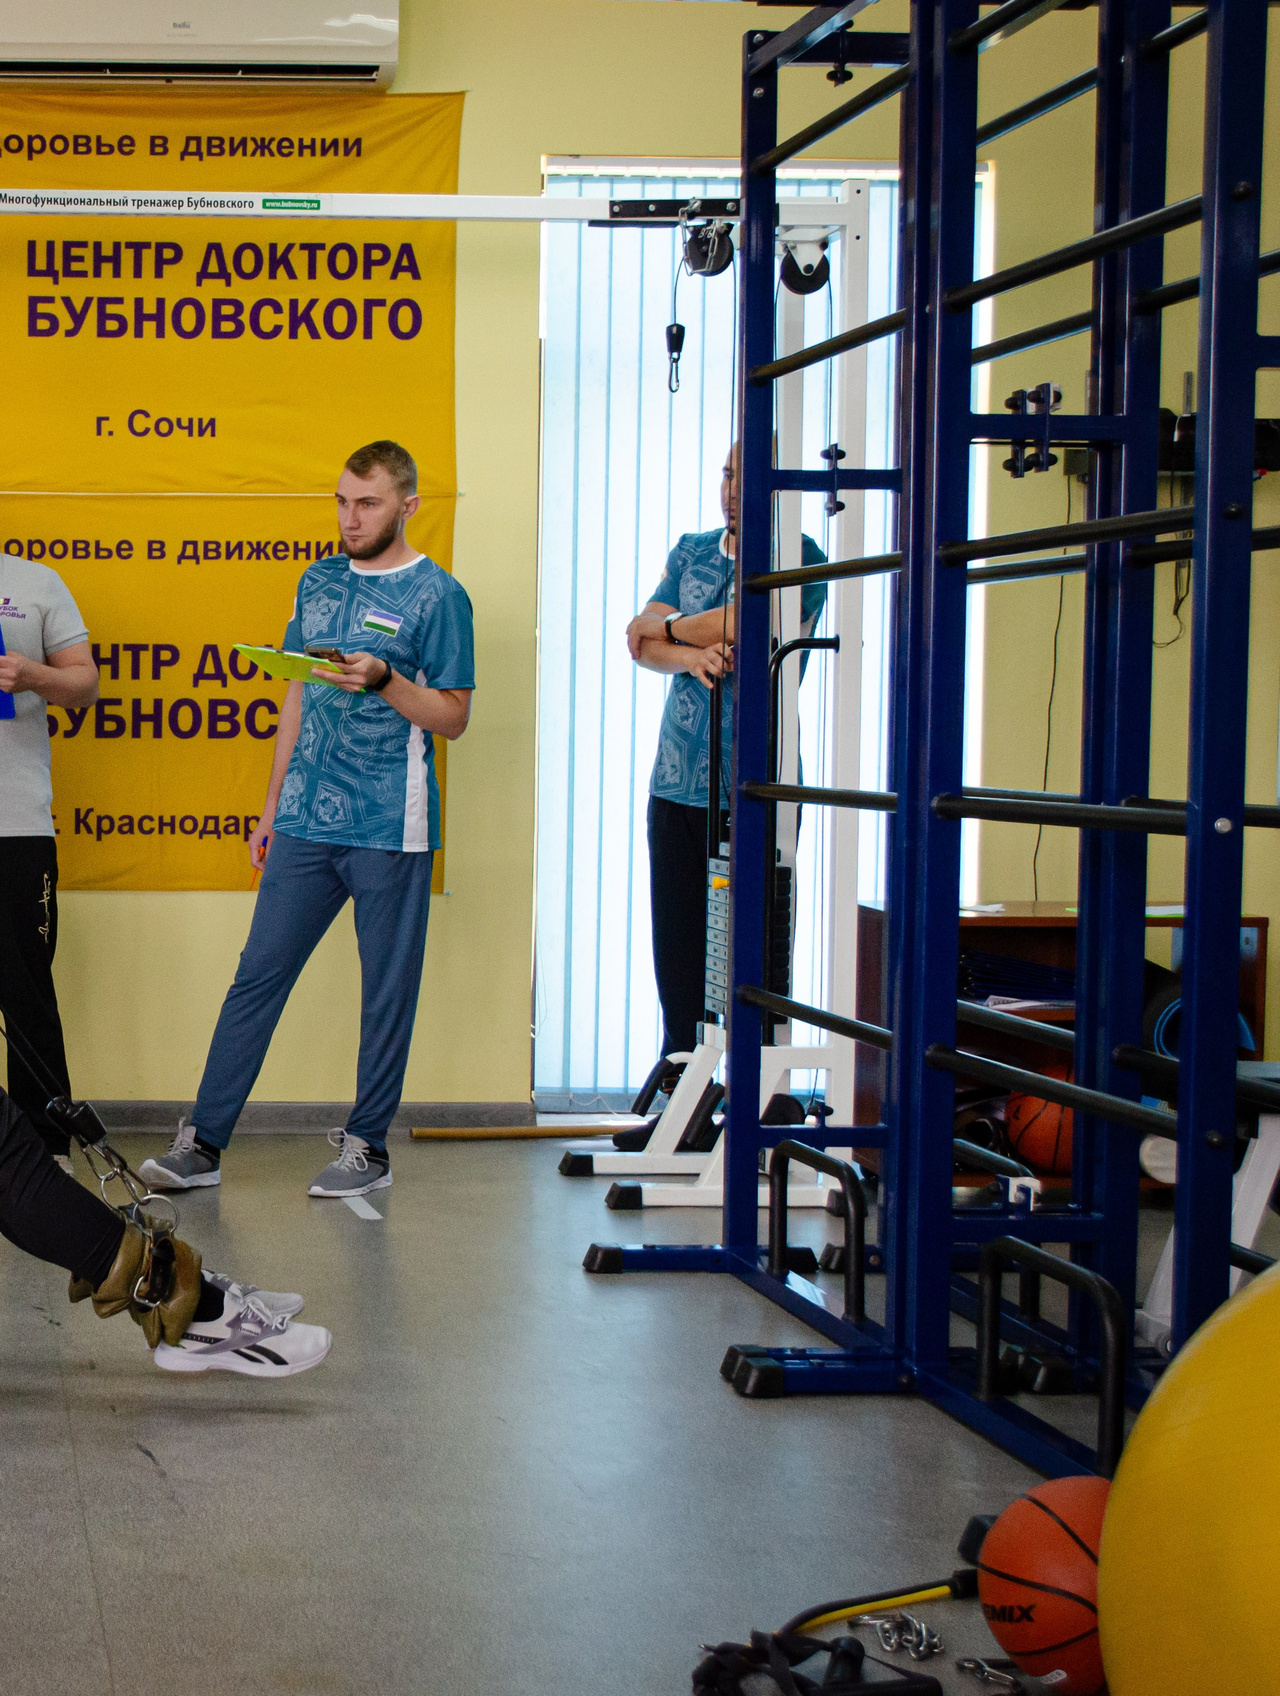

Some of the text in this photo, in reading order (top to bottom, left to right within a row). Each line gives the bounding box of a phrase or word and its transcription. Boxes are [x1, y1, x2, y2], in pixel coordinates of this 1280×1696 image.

[149, 141, 169, 157] в
[179, 140, 363, 162] движении
[131, 198, 183, 210] тренажер
[187, 196, 255, 210] Бубновского
[26, 240, 422, 288] ЦЕНТР ДОКТОРА
[27, 296, 423, 341] БУБНОВСКОГО
[96, 409, 216, 438] г. Сочи
[147, 540, 167, 560] в
[177, 540, 345, 565] движени
[74, 807, 261, 842] Краснодар
